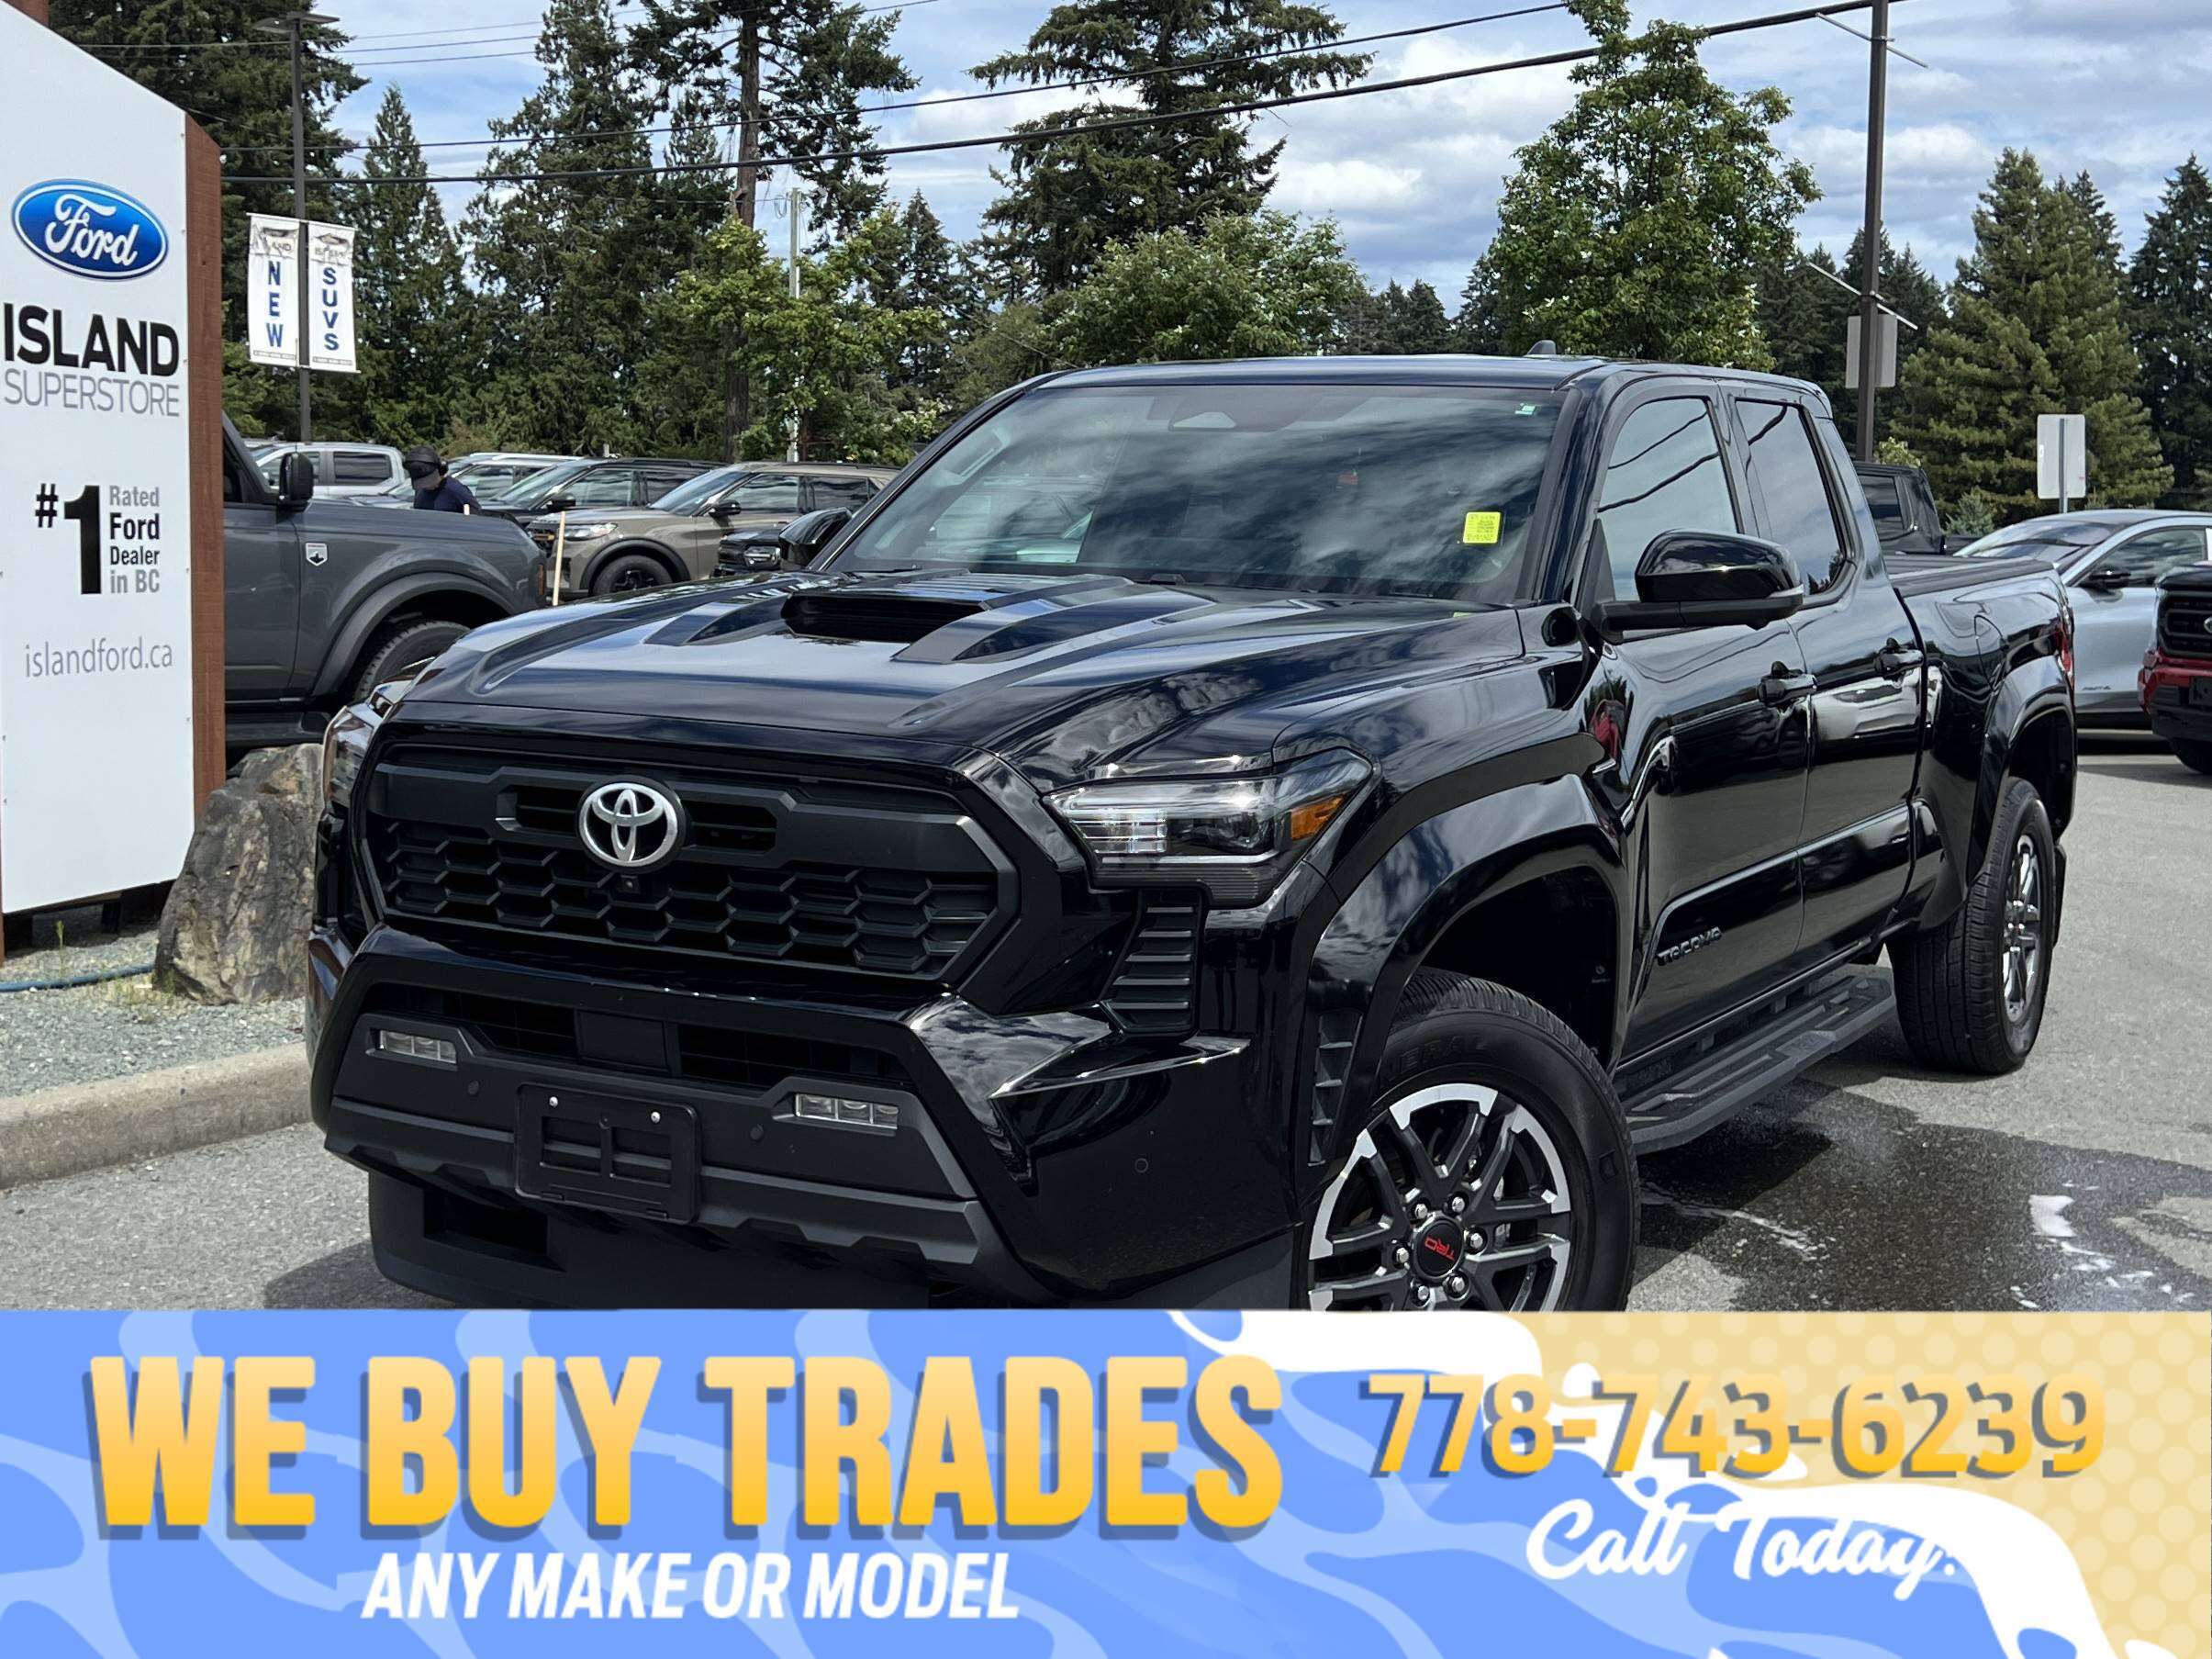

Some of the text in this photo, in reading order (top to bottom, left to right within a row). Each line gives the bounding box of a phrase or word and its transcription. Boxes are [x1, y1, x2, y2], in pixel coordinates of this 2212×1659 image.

[44, 193, 140, 266] Ford
[265, 261, 284, 348] NEW
[3, 302, 180, 377] ISLAND
[4, 368, 180, 418] SUPERSTORE
[109, 485, 160, 507] Rated
[35, 483, 102, 595] #1
[109, 512, 160, 540] Ford
[110, 545, 160, 566] Dealer
[110, 569, 160, 594] in BC
[26, 636, 173, 678] islandford.ca
[1656, 926, 1722, 965] TACOMA
